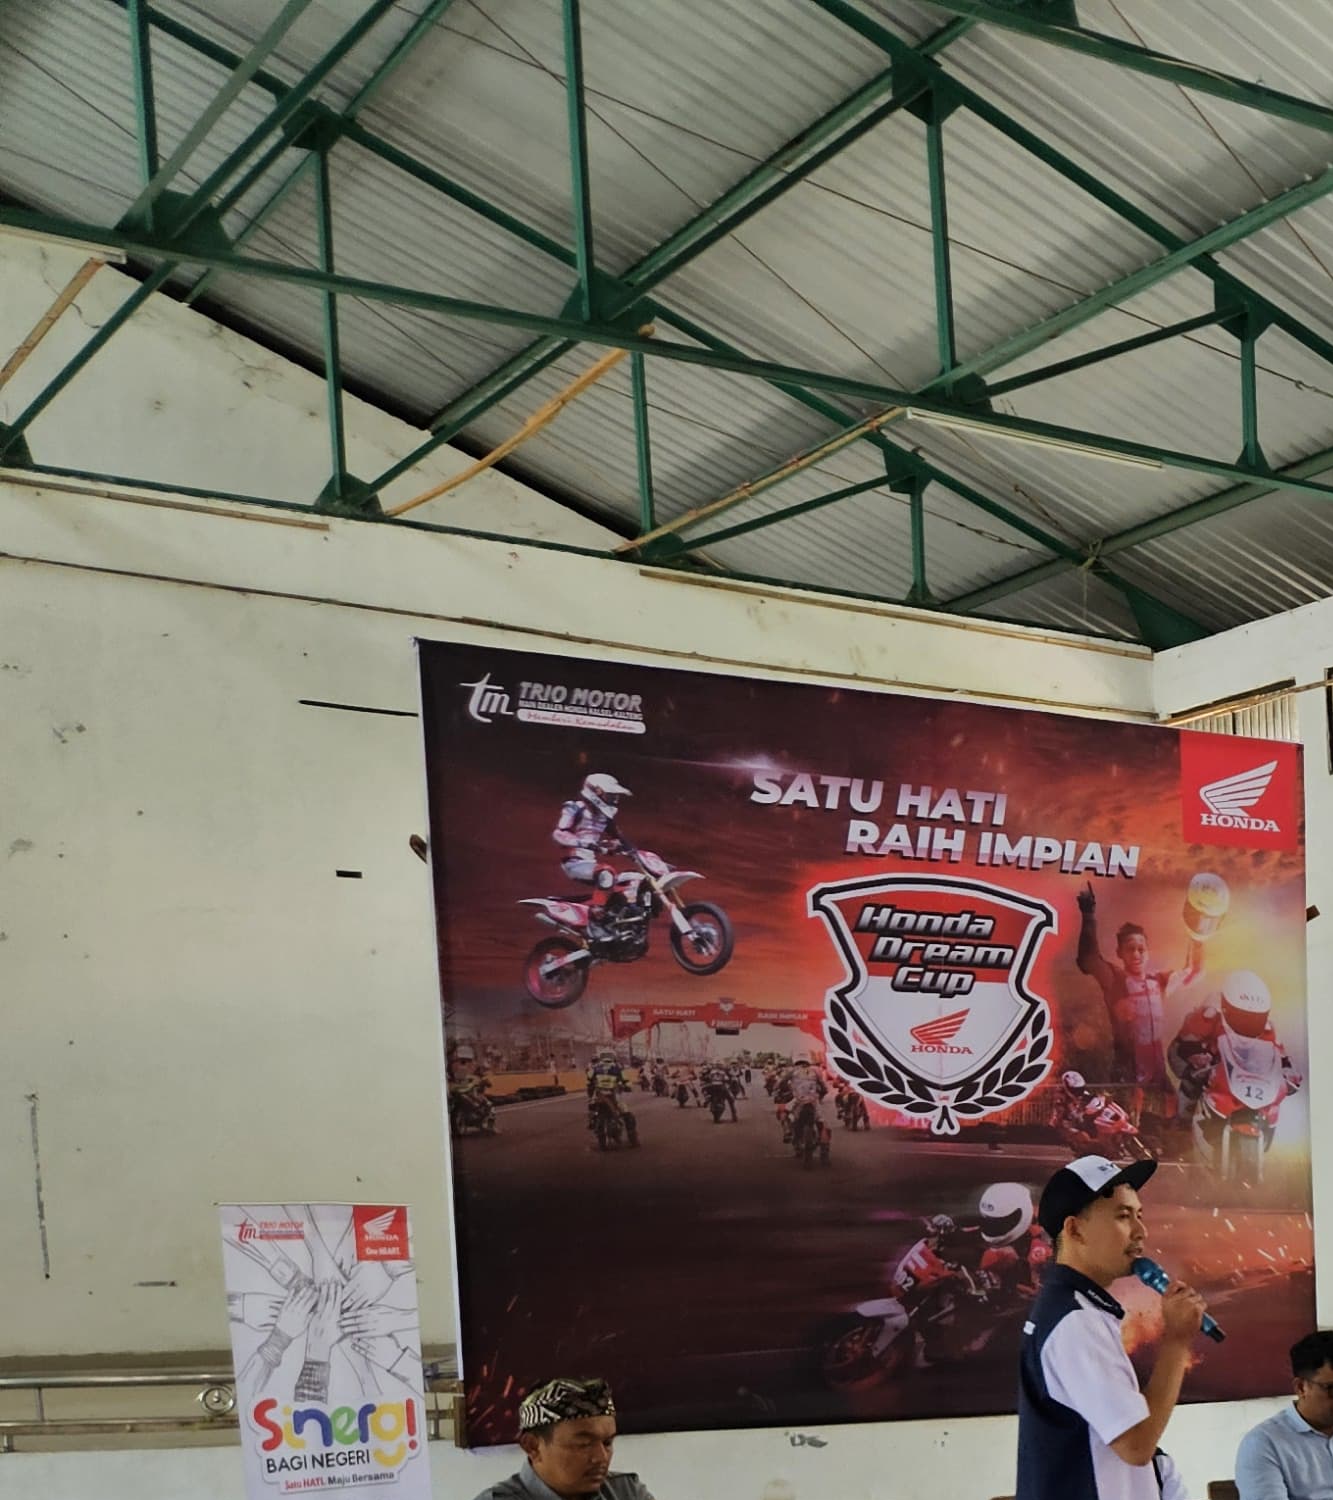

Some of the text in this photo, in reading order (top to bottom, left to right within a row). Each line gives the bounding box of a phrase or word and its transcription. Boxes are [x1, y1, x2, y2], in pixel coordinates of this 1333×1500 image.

[520, 681, 643, 712] TRIO MOTOR
[537, 702, 563, 712] DEALER
[750, 773, 1009, 827] SATU HATI
[1200, 813, 1281, 832] HONDA
[844, 819, 1141, 878] RAIH IMPIAN
[856, 904, 995, 938] Honda
[871, 935, 1015, 967] Dream
[893, 966, 975, 997] Cup
[911, 1044, 974, 1055] HONDA
[1244, 1086, 1264, 1100] 12
[266, 1449, 371, 1474] BAGI NEGERI
[285, 1480, 302, 1490] Satu
[328, 1475, 350, 1487] Maju
[352, 1472, 395, 1483] Bersama
